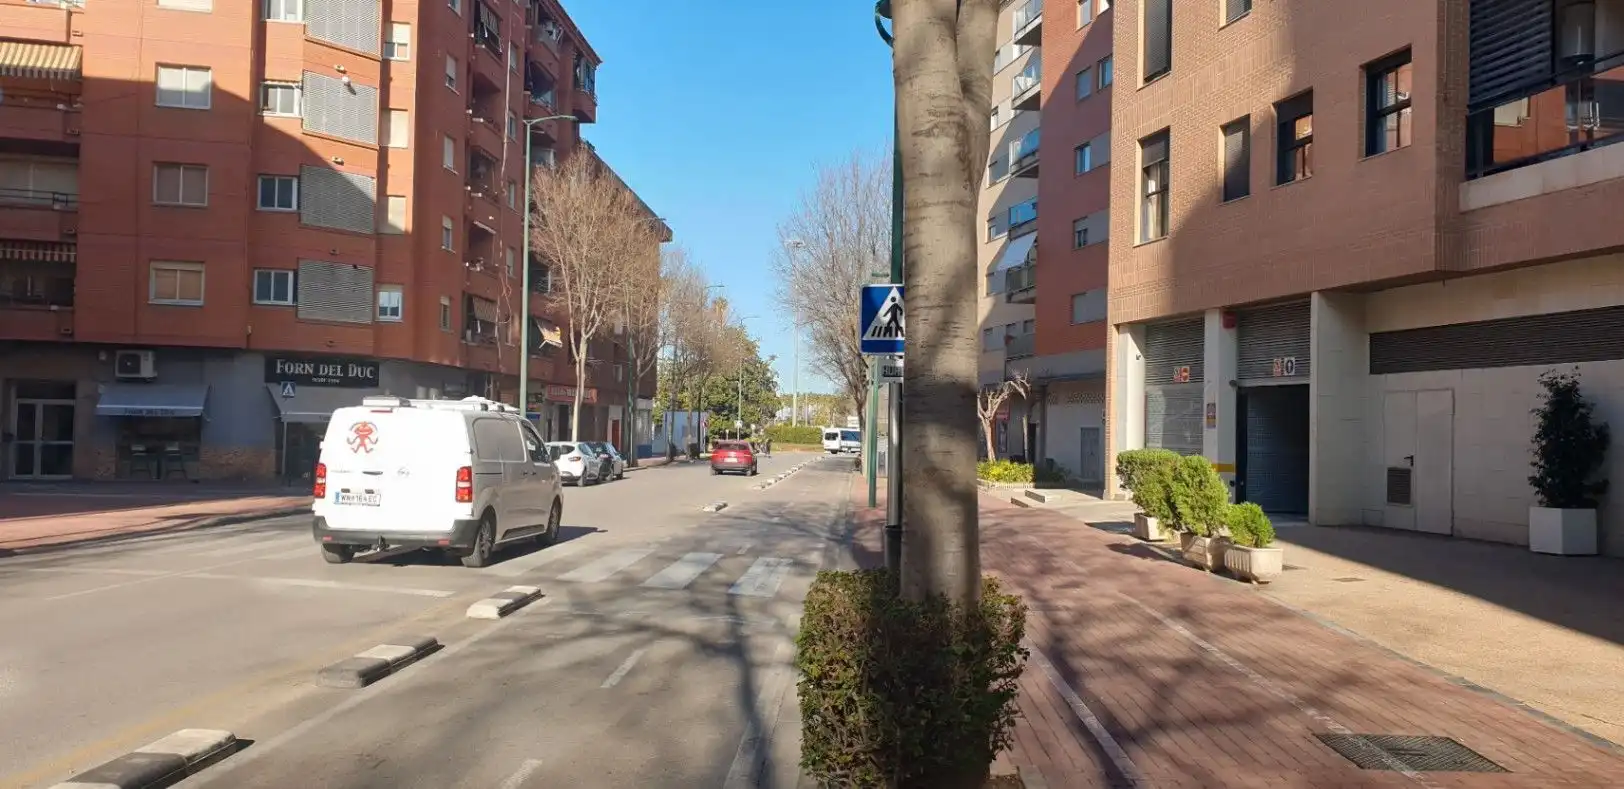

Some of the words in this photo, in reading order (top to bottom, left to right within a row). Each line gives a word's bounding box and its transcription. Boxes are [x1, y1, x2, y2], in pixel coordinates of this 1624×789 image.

[275, 359, 314, 375] FORN
[319, 364, 344, 377] DEL
[348, 363, 375, 378] DUC
